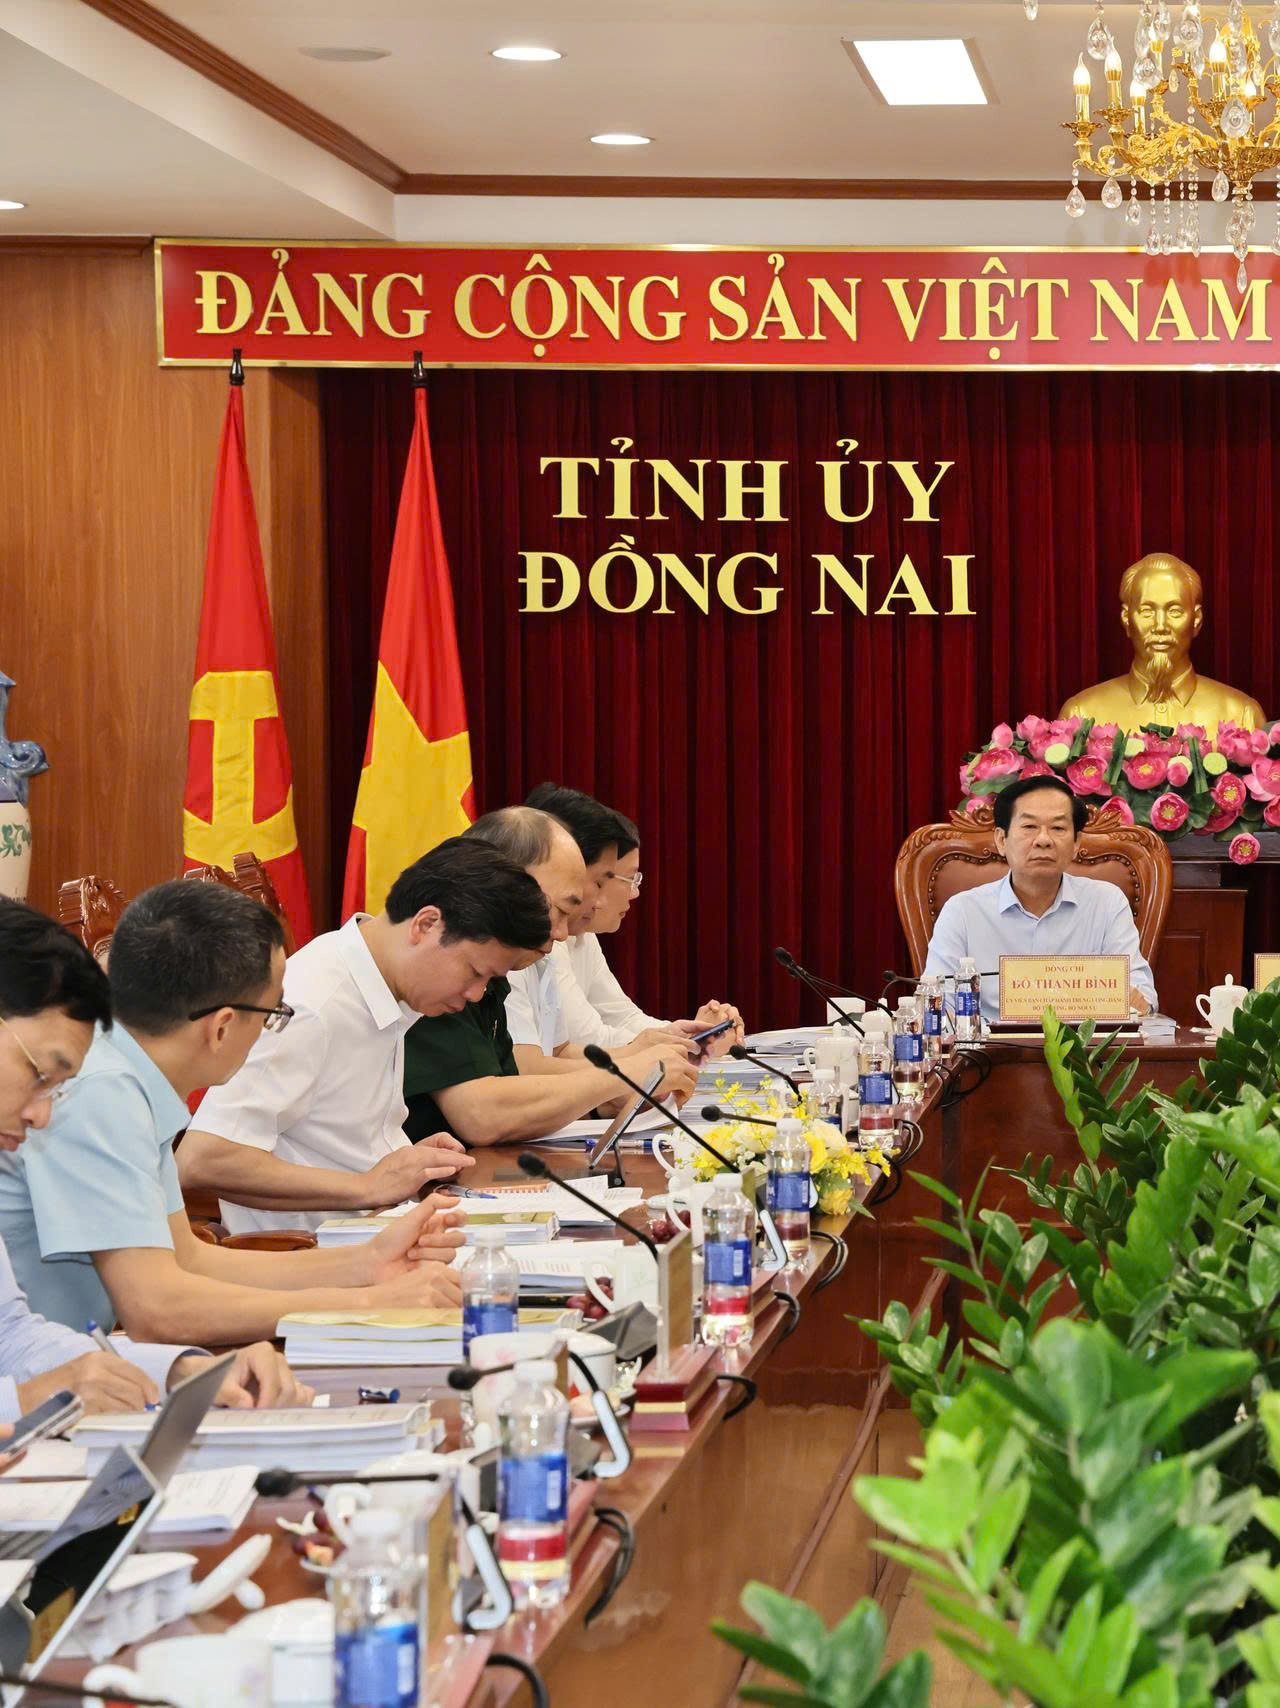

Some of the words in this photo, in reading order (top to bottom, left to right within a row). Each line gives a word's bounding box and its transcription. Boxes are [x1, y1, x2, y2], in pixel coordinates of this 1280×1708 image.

[195, 248, 431, 338] ĐẢNG
[455, 253, 686, 357] CỘNG
[708, 253, 861, 342] SẢN
[882, 256, 1069, 360] VIỆT
[1089, 277, 1272, 342] NAM
[540, 436, 790, 522] TỈNH
[816, 438, 956, 523] ỦY
[517, 534, 785, 616] ĐỒNG
[812, 554, 977, 616] NAI
